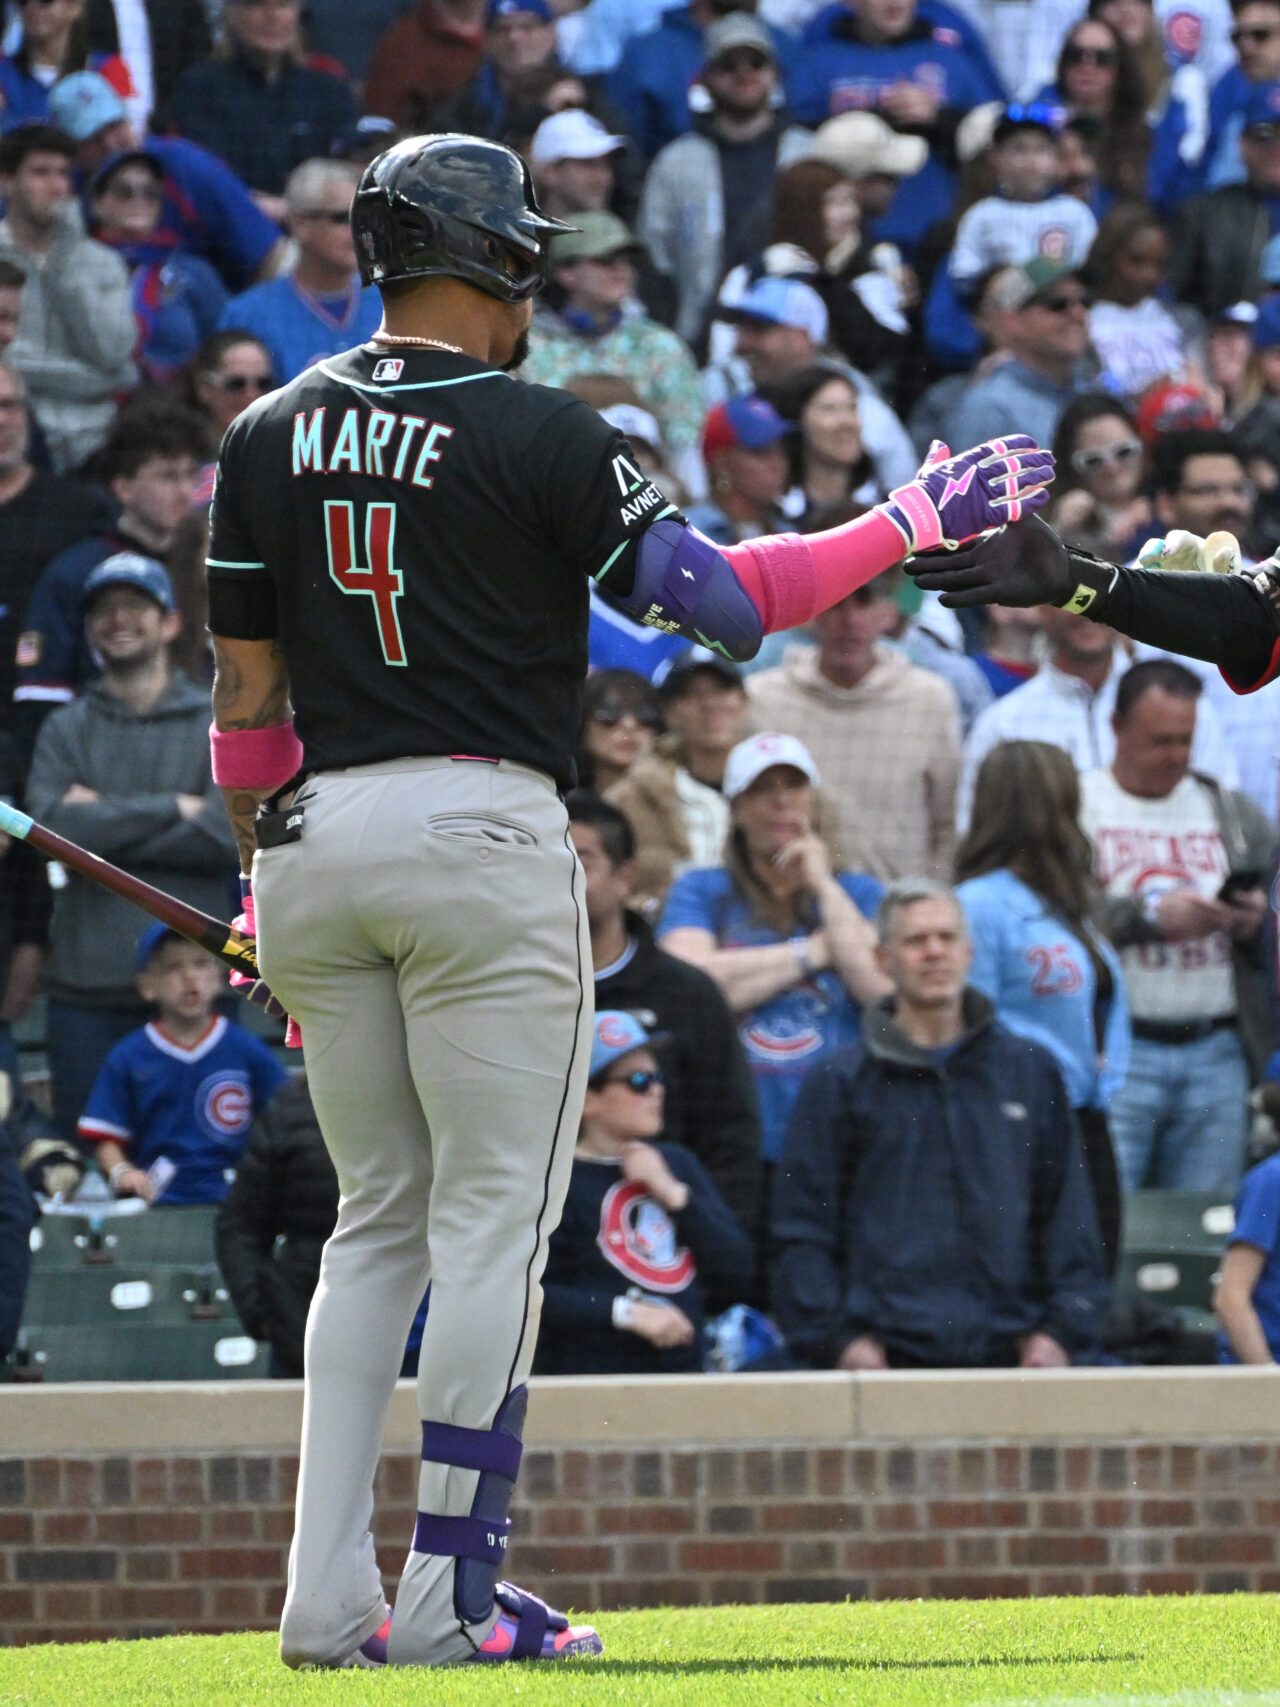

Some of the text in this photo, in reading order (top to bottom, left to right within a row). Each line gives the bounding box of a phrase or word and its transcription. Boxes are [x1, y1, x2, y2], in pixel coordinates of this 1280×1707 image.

[291, 406, 455, 490] MARTE
[620, 482, 664, 527] AVNET
[323, 500, 409, 668] 4
[1025, 944, 1082, 997] 25
